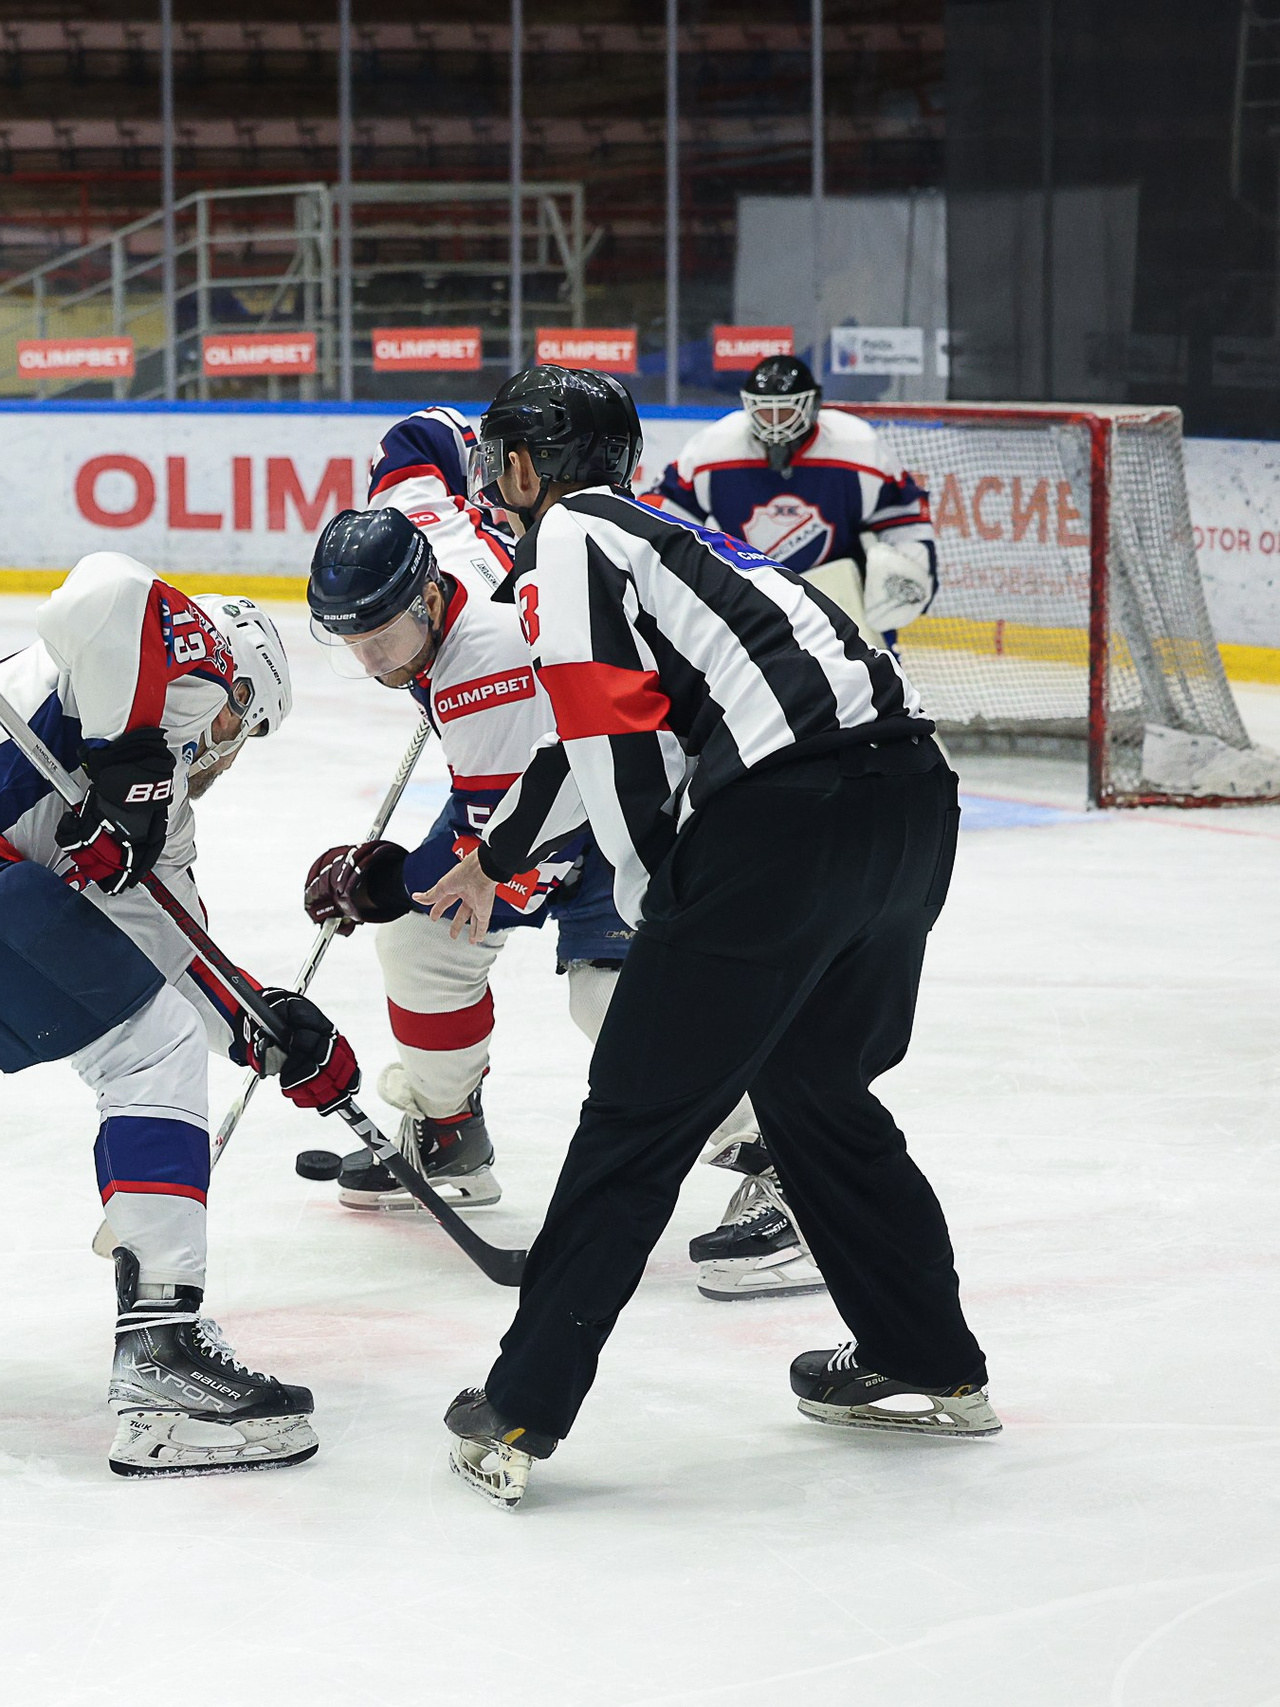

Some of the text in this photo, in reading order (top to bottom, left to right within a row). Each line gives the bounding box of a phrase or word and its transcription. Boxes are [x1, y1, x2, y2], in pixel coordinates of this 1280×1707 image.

[19, 346, 130, 369] OLIMPBET
[205, 343, 313, 367] OLIMPBET
[375, 339, 478, 360] OLIMPBET
[537, 340, 633, 361] OLIMPBET
[74, 453, 355, 533] OLIM
[1192, 526, 1250, 551] OTOR
[323, 613, 357, 621] BAUER
[171, 608, 207, 665] 13
[261, 652, 282, 686] BAUER
[437, 675, 530, 714] OLIMPBET
[35, 743, 58, 771] NANOLITE
[123, 1352, 226, 1413] VAPOR
[189, 1370, 241, 1401] BAUER
